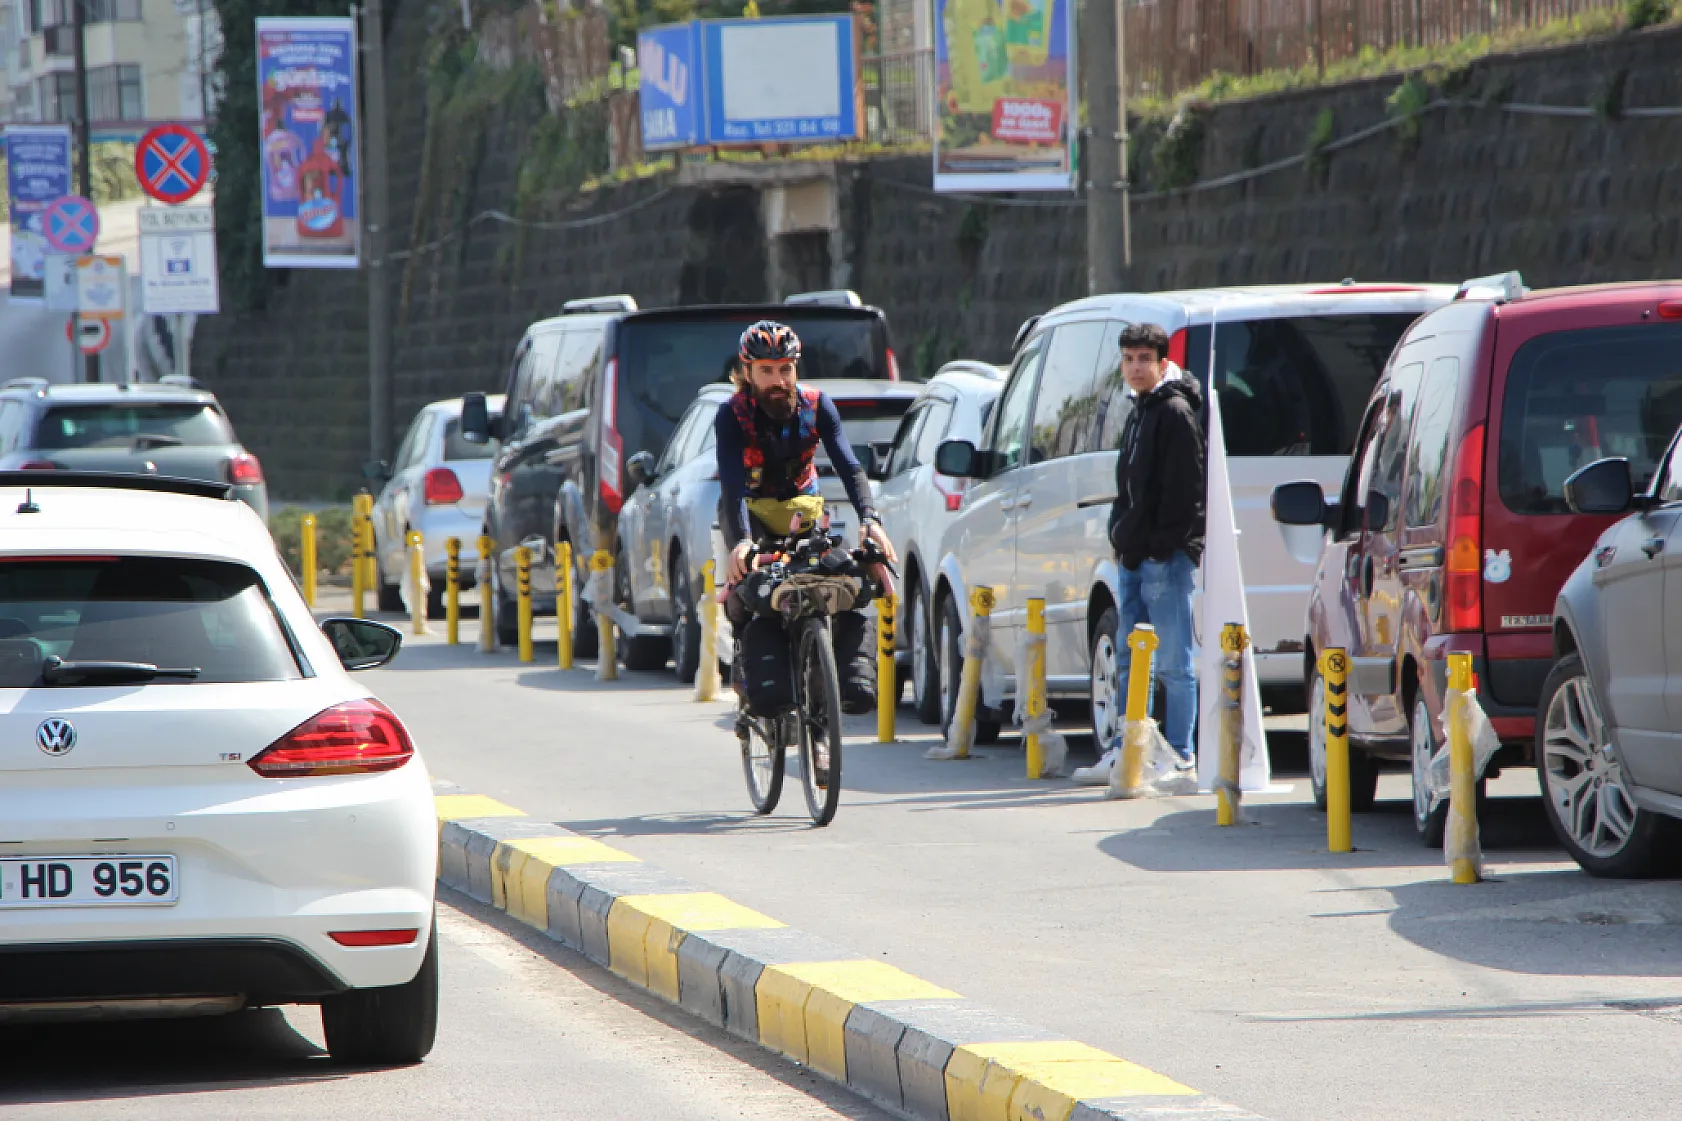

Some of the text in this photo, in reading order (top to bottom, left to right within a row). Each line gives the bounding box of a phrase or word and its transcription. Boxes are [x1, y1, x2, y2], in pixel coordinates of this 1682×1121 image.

[219, 752, 241, 761] TSI
[21, 862, 171, 898] HD 956
